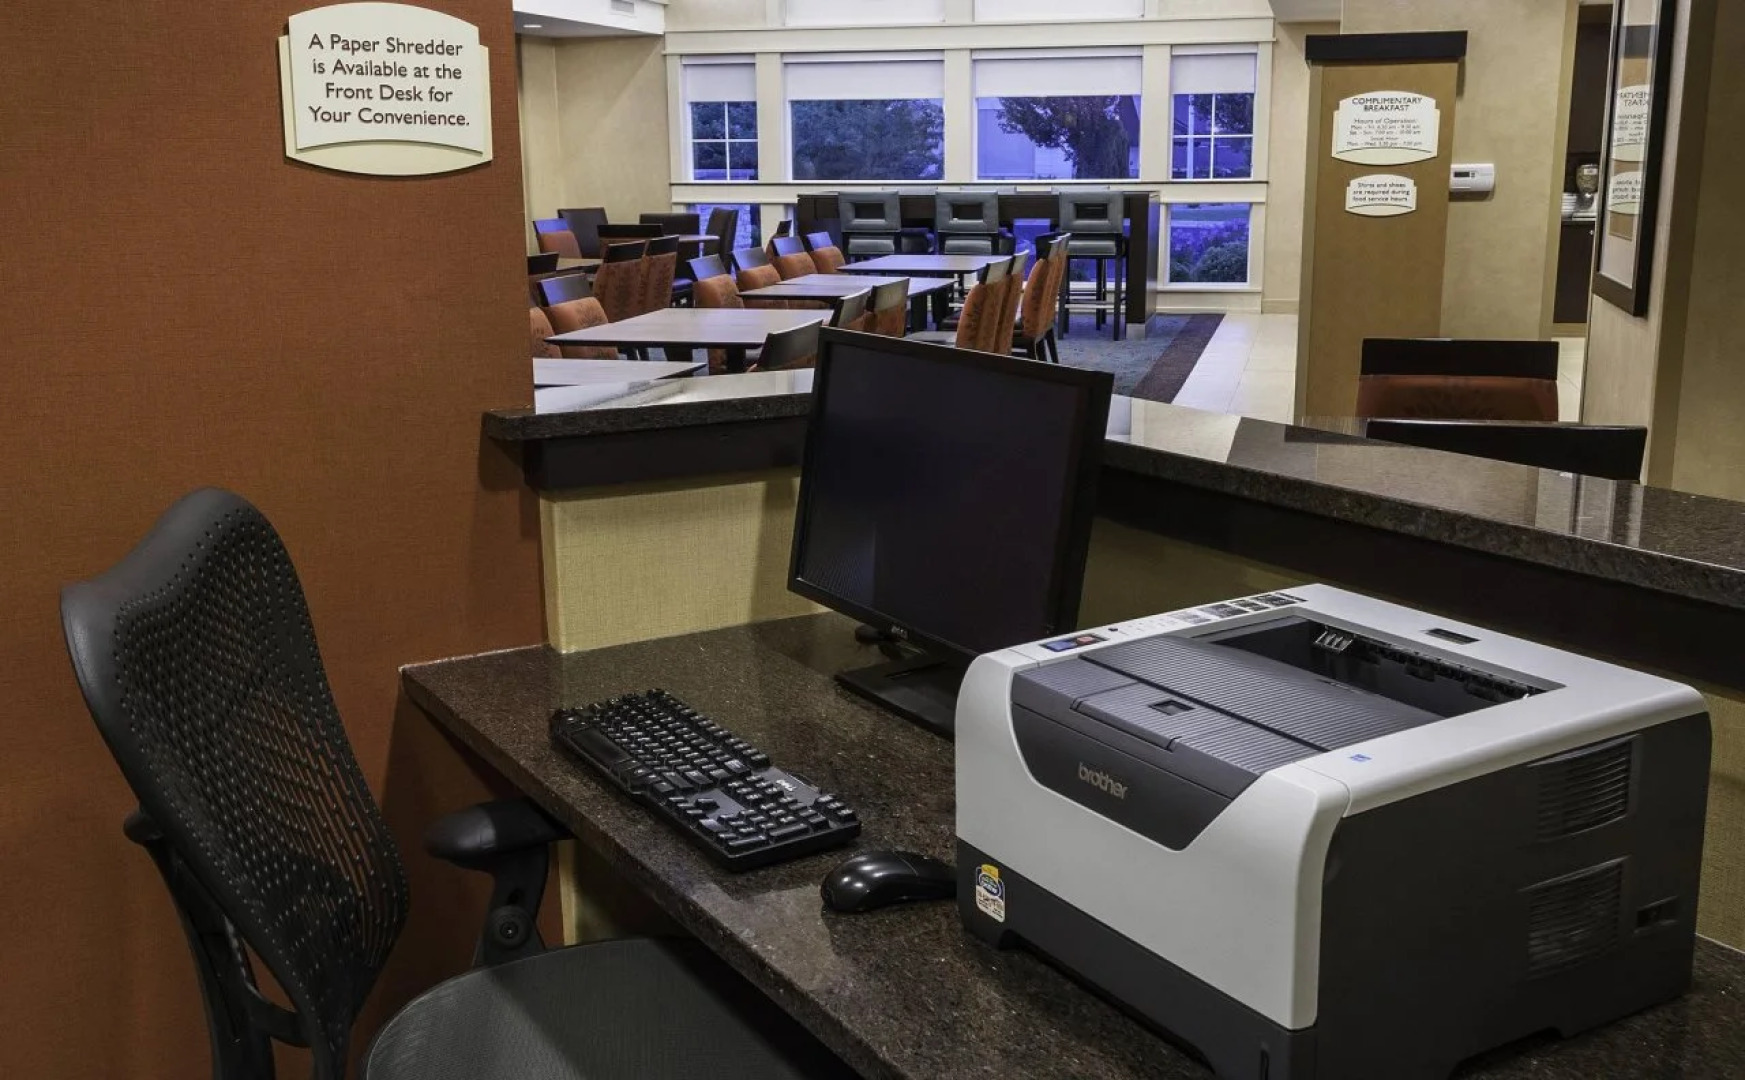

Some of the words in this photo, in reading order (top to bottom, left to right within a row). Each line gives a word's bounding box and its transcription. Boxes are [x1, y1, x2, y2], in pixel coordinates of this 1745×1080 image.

[308, 33, 324, 50] A
[330, 33, 380, 56] Paper
[386, 37, 463, 56] Shredder
[312, 59, 325, 74] is
[332, 59, 407, 77] Available
[414, 66, 430, 79] at
[435, 63, 462, 80] the
[325, 82, 373, 100] Front
[379, 84, 424, 101] Desk
[428, 86, 453, 102] for
[308, 106, 351, 123] Your
[358, 108, 470, 126] Convenience.
[1079, 761, 1128, 799] brother
